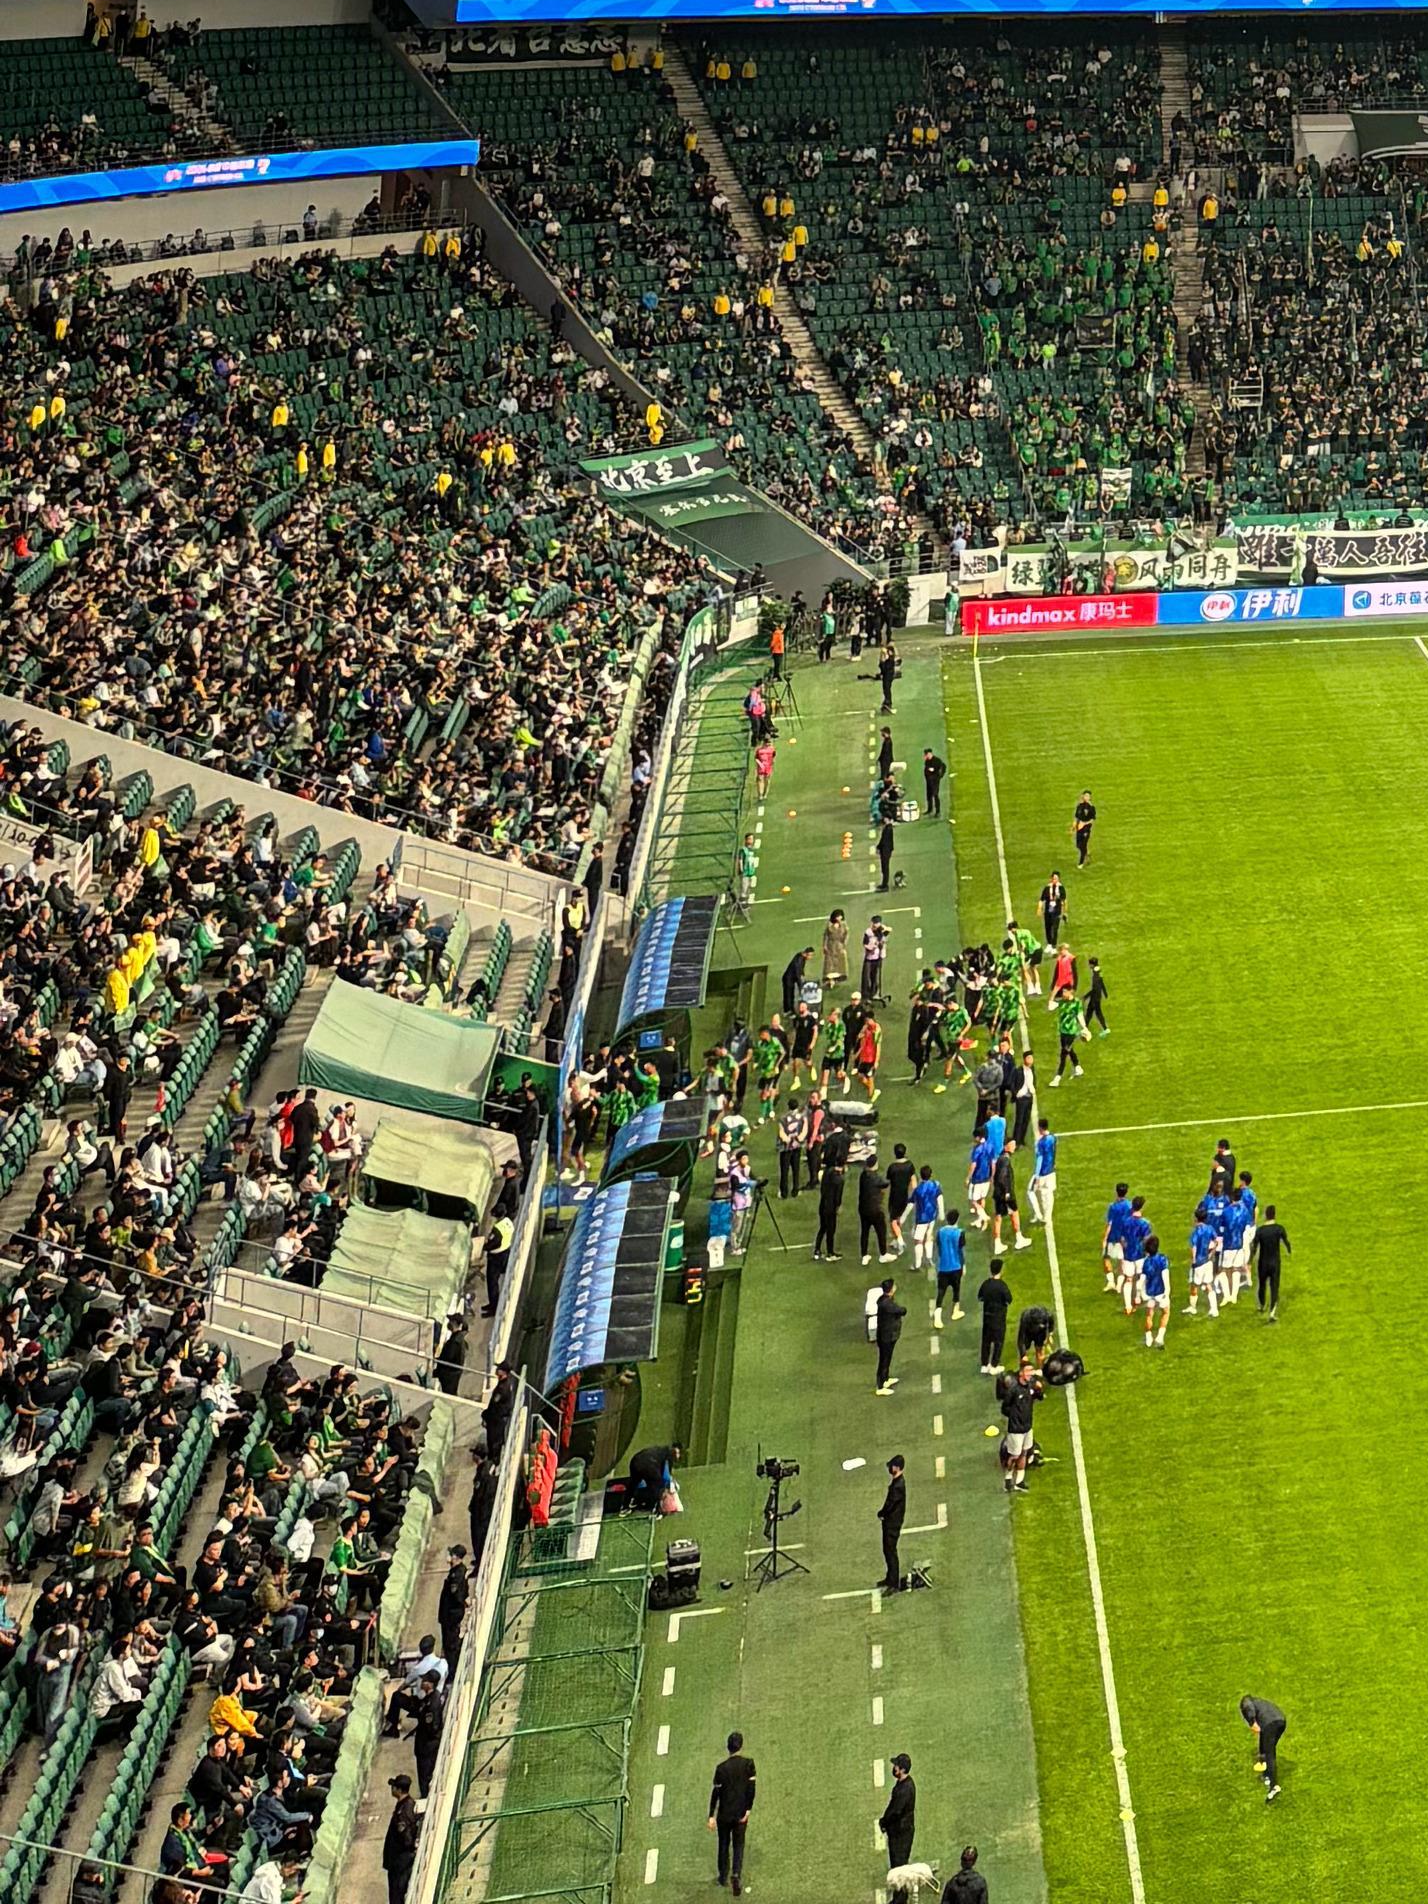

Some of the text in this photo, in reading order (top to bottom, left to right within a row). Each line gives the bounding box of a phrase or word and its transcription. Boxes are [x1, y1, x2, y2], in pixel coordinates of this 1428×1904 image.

[600, 451, 715, 492] 北京至上
[987, 601, 1133, 627] kindmax 康玛士
[1241, 589, 1301, 619] 伊利
